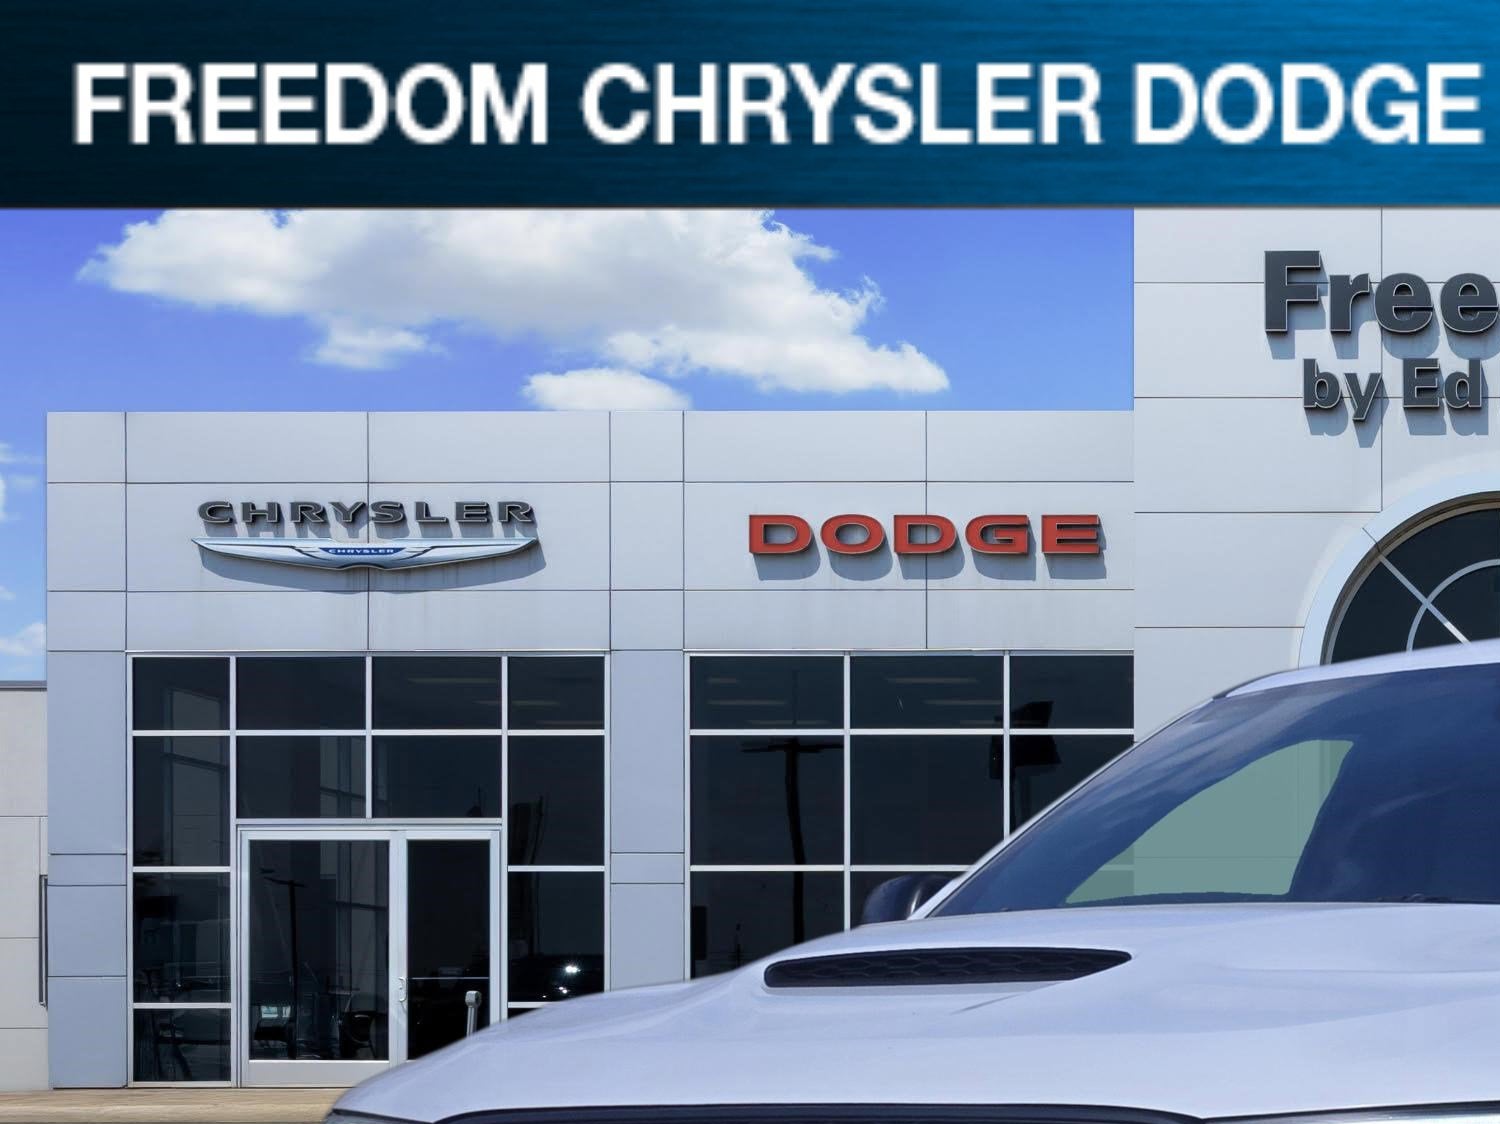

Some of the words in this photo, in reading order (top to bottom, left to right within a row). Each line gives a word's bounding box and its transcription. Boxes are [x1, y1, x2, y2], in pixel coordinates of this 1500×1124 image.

[1302, 358, 1382, 421] by
[1402, 358, 1483, 409] Ed
[197, 500, 533, 524] CHRYSLER
[748, 513, 1101, 555] DODGE
